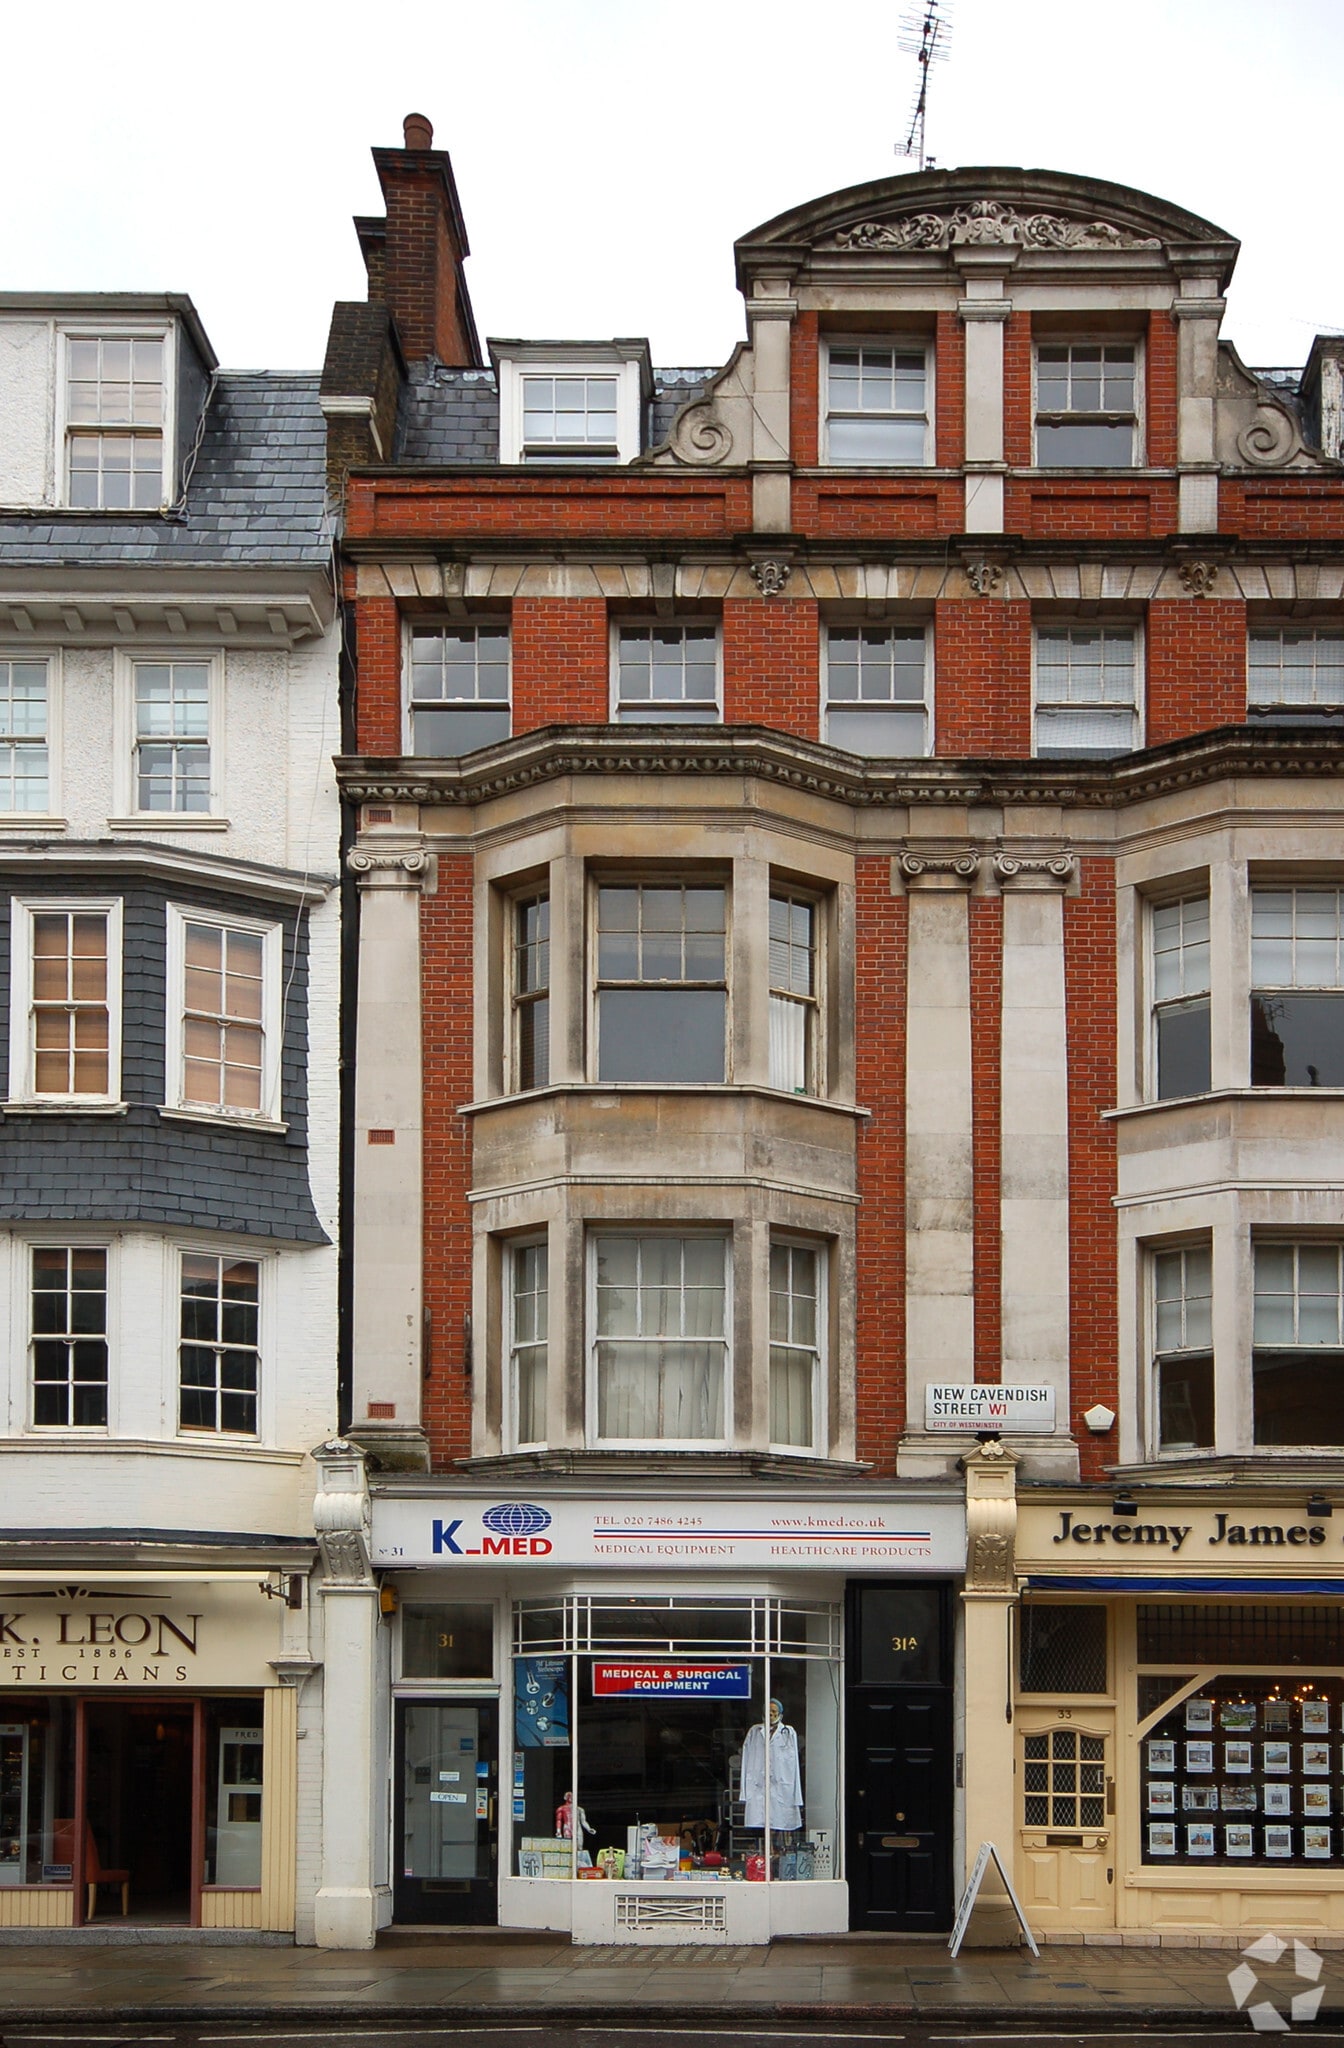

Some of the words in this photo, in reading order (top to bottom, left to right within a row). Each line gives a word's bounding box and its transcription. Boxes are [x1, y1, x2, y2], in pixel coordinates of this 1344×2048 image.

[933, 1388, 965, 1401] NEW
[970, 1389, 1048, 1401] CAVENDISH
[933, 1402, 983, 1415] STREET
[988, 1403, 1007, 1416] W1
[933, 1421, 947, 1429] CITY
[594, 1516, 620, 1525] TEL.
[624, 1517, 644, 1525] 020
[648, 1517, 673, 1526] 7486
[677, 1518, 702, 1526] 4245
[771, 1516, 886, 1528] www.kmed.co.uk
[1053, 1512, 1192, 1552] Jeremy
[1209, 1513, 1326, 1546] James
[391, 1547, 403, 1556] 31
[594, 1544, 655, 1554] MEDICAL
[657, 1545, 736, 1555] EQUIPMENT
[771, 1546, 857, 1556] HEALTHCARE
[862, 1547, 932, 1556] PRODUCTS
[56, 1613, 203, 1656] LEON
[438, 1634, 454, 1648] 31
[3, 1648, 40, 1658] EST
[79, 1648, 132, 1658] 1886
[602, 1669, 659, 1679] MEDICAL
[663, 1671, 672, 1679] &
[676, 1670, 741, 1680] SURGICAL
[634, 1681, 710, 1690] EQUIPMENT
[1057, 1709, 1072, 1719] 33
[816, 1832, 827, 1842] T
